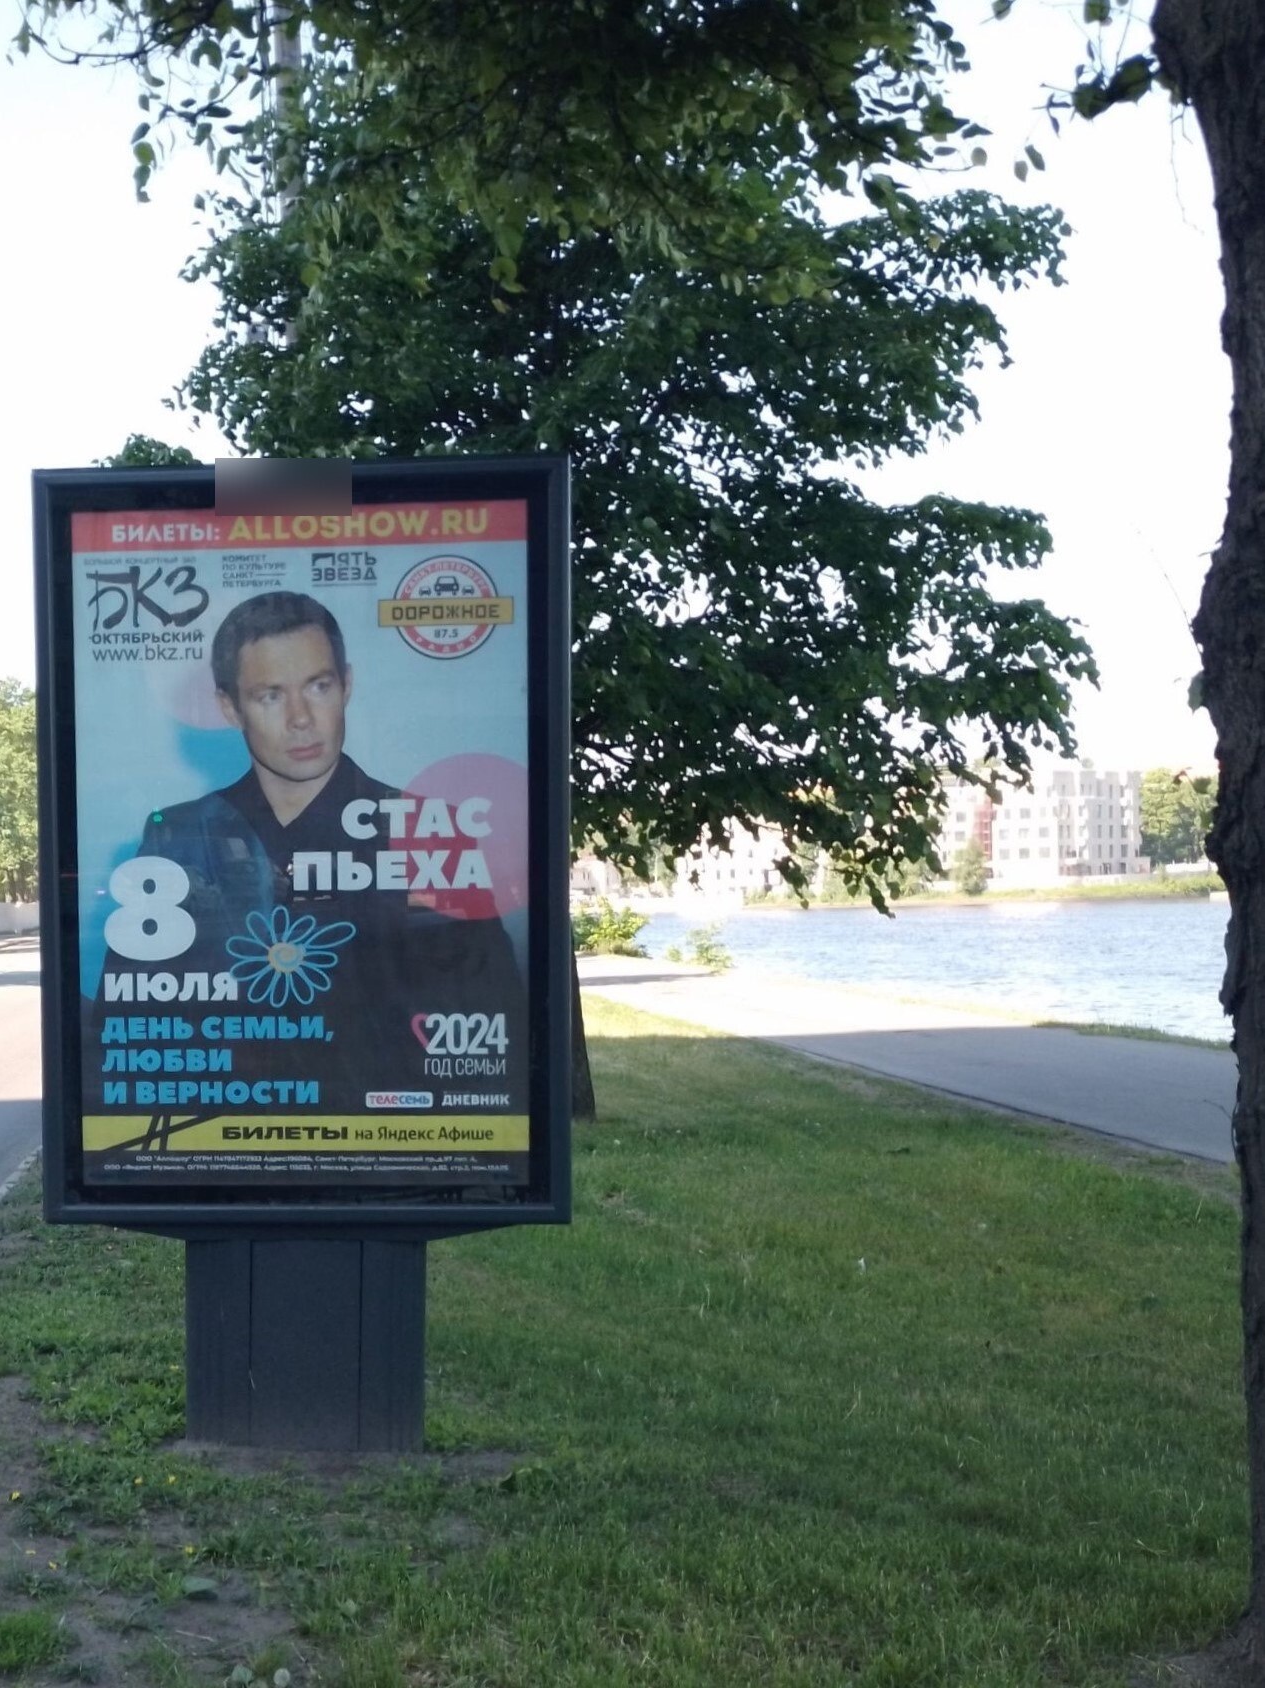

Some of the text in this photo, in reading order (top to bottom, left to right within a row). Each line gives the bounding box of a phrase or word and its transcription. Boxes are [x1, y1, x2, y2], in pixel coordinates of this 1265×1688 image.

[111, 508, 489, 543] БИЛЕТЫ: ALLOSHOW.RU
[222, 554, 266, 563] КОМИТЕТ
[222, 563, 236, 571] ПО
[311, 551, 377, 567] ПЯТЬ
[311, 567, 377, 582] ЗВЕЗД
[222, 580, 281, 588] ПЕТЕРБУРГА
[85, 565, 210, 632] БКЗ
[391, 604, 501, 621] ДОРОЖНОЕ
[91, 630, 204, 645] ОКТЯБРЬСКИЙ
[434, 628, 459, 639] 87.5
[92, 644, 204, 662] www.bkz.ru
[415, 635, 478, 653] РАДИО
[340, 797, 493, 840] СТАС
[291, 850, 494, 892] ПЬЕХА
[103, 855, 197, 962] 8
[103, 972, 239, 1003] ИЮЛЯ
[101, 1016, 334, 1044] ДЕНЬ СЕМЬИ,
[425, 1012, 510, 1055] 2024
[101, 1048, 233, 1072] ЛЮБВИ
[424, 1058, 452, 1078] ГОД
[103, 1080, 320, 1105] И ВЕРНОСТИ
[441, 1094, 510, 1107] ДНЕВНИК
[222, 1126, 494, 1142] БИЛЕТЫ на Яндекс Афише
